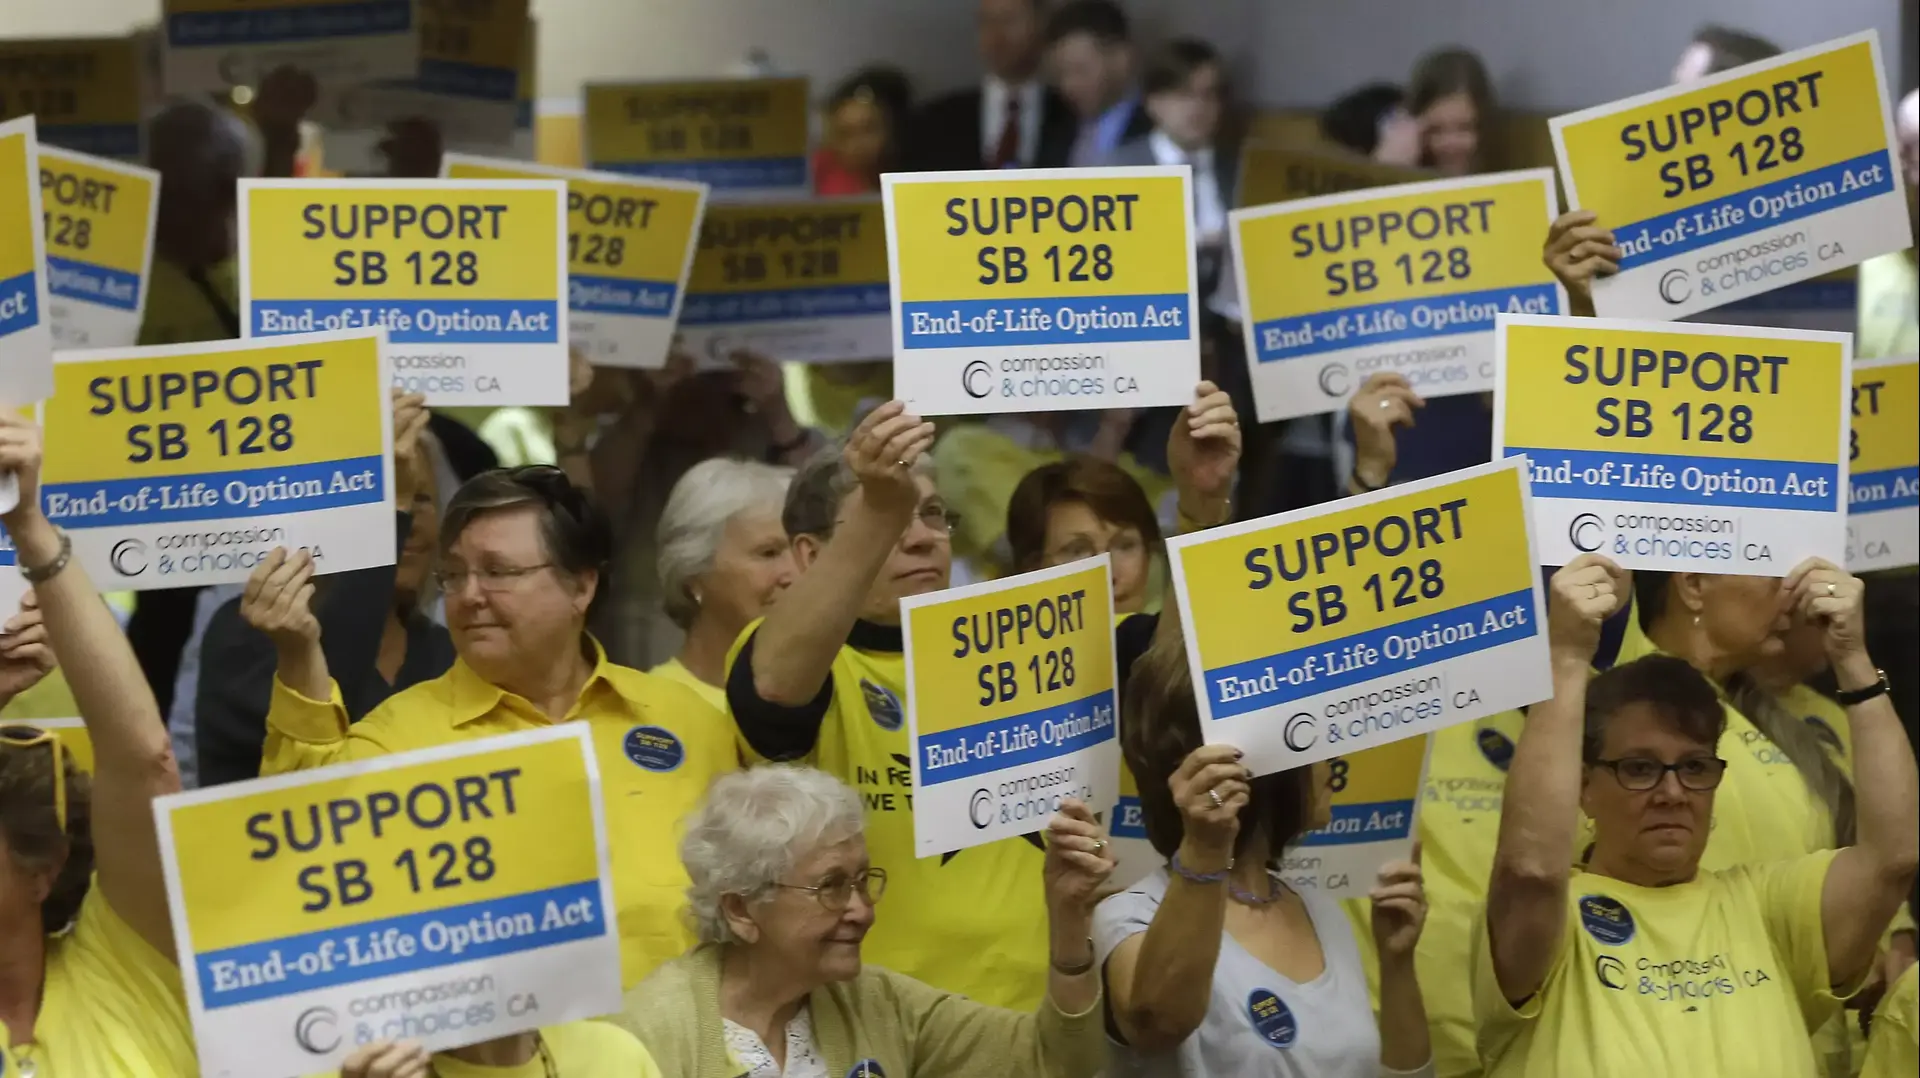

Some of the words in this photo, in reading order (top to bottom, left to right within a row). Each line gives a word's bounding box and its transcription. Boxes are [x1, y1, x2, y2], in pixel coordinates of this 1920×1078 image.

[1620, 71, 1823, 161] SUPPORT
[1659, 152, 1715, 198] SB
[1728, 126, 1804, 176] 128
[39, 168, 118, 214] PORT
[568, 191, 659, 229] PORT
[1613, 207, 1745, 258] nd-of-Life
[1748, 184, 1837, 223] Option
[1839, 165, 1884, 193] Act
[43, 211, 92, 250] 128
[302, 203, 508, 239] SUPPORT
[946, 194, 1139, 236] SUPPORT
[1290, 199, 1494, 259] SUPPORT
[333, 250, 388, 286] SB
[404, 250, 479, 286] 128
[568, 233, 626, 267] 128
[977, 246, 1028, 285] SB
[1043, 244, 1114, 282] 128
[1696, 230, 1805, 273] compassion
[1701, 279, 1715, 296] &
[1720, 251, 1809, 290] choices
[1818, 241, 1845, 262] CA
[1325, 259, 1379, 296] SB
[1394, 247, 1471, 285] 128
[0, 291, 29, 321] ct
[260, 308, 411, 332] End-of-Life
[416, 308, 501, 334] Option
[504, 309, 549, 332] Act
[911, 306, 1051, 335] End-of-Life
[1056, 305, 1138, 335] Option
[1142, 305, 1182, 327] Act
[1263, 312, 1407, 351] End-of-Life
[1411, 301, 1499, 331] Option
[1506, 294, 1549, 315] Act
[388, 354, 465, 372] passion
[1000, 353, 1104, 375] compassion
[1355, 345, 1466, 370] compassion
[1406, 363, 1468, 386] oices
[1478, 362, 1494, 378] C
[1564, 344, 1789, 395] SUPPORT
[89, 359, 324, 416] SUPPORT
[392, 373, 464, 394] hoices
[474, 376, 502, 393] CA
[1001, 378, 1016, 397] &
[1020, 375, 1104, 396] choices
[1113, 376, 1139, 394] CA
[126, 423, 189, 464] SB
[207, 413, 295, 456] 128
[1595, 397, 1653, 438] SB
[1671, 402, 1754, 444] 128
[46, 482, 219, 517] End-of-Life
[224, 475, 324, 507] Option
[328, 469, 376, 493] Act
[1681, 467, 1777, 497] Option
[1781, 472, 1829, 498] Act
[1849, 484, 1887, 504] ion
[1892, 476, 1919, 499] Ac
[156, 524, 285, 550] compassion
[1614, 511, 1734, 534] compassion
[158, 554, 174, 574] &
[189, 547, 268, 572] choice
[1244, 498, 1468, 591] SUPPORT
[1613, 534, 1630, 555] &
[1634, 534, 1732, 560] choices
[1743, 543, 1772, 561] CA
[1864, 540, 1891, 559] CA
[1287, 584, 1348, 634] SB
[1362, 559, 1445, 614] 128
[952, 589, 1085, 659] SUPPORT
[1216, 636, 1378, 704] End-of-Life
[1382, 615, 1476, 661] Option
[1480, 603, 1527, 636] Act
[978, 661, 1018, 707] SB
[1028, 647, 1075, 694] 128
[1324, 673, 1442, 718] compassion
[926, 724, 1038, 770] End-of-Life
[1040, 710, 1091, 746] Option
[1092, 706, 1112, 730] Act
[1326, 724, 1344, 745] &
[1347, 695, 1443, 740] choices
[1452, 689, 1482, 711] CA
[857, 766, 878, 785] IN
[887, 767, 911, 787] RE
[246, 768, 521, 861] SUPPORT
[1000, 803, 1011, 824] &
[1315, 818, 1360, 836] ion
[1364, 810, 1404, 832] Act
[298, 859, 374, 913] SB
[394, 836, 496, 893] 128
[1326, 874, 1349, 889] CA
[209, 927, 416, 993] End-of-Life
[421, 911, 536, 955] Option
[540, 897, 594, 931] Act
[347, 972, 494, 1018] compassion
[1638, 976, 1654, 994] &
[1743, 969, 1771, 987] CA
[353, 1022, 375, 1045] &
[381, 1000, 496, 1042] choices
[506, 992, 538, 1018] CA
